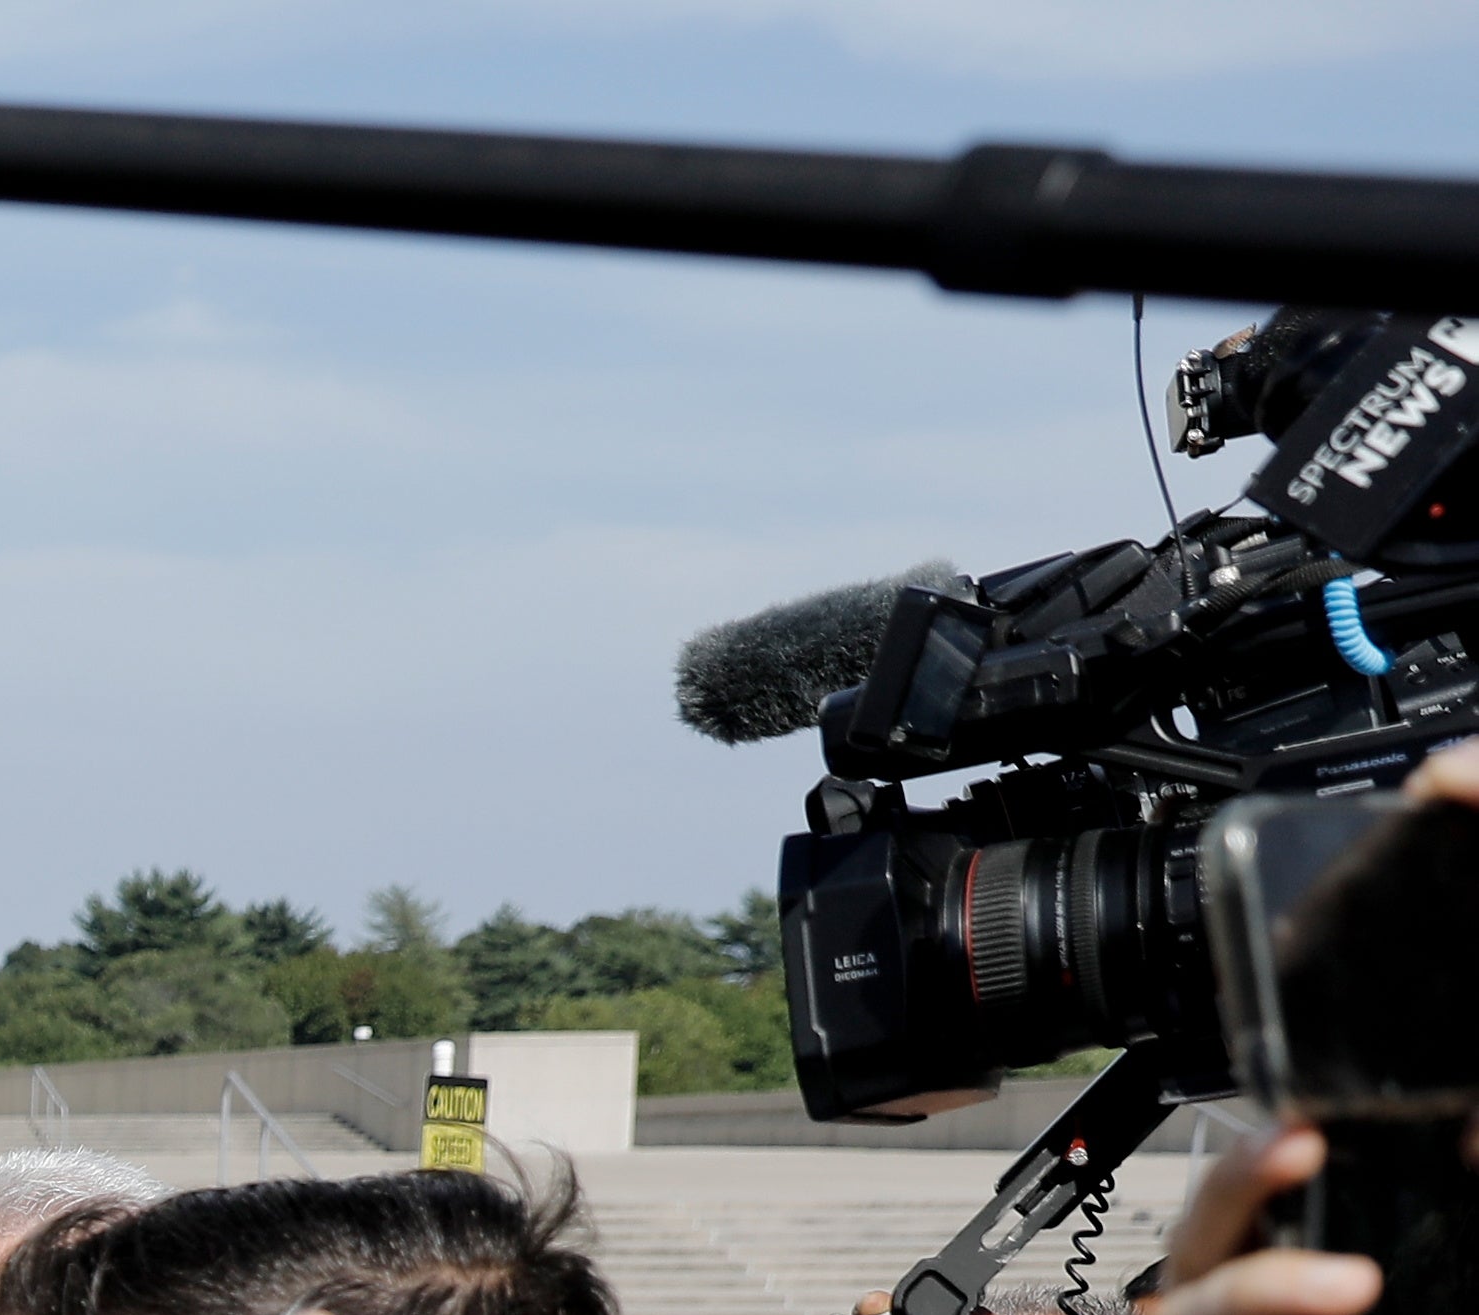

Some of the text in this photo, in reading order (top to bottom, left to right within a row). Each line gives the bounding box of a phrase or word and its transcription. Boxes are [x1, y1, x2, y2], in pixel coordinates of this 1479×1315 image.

[1287, 346, 1437, 505] SPECTRUM
[1337, 360, 1467, 489] NEWS
[1316, 752, 1410, 777] Panasonic
[834, 952, 876, 969] LEICA
[427, 1084, 485, 1122] CAUTION
